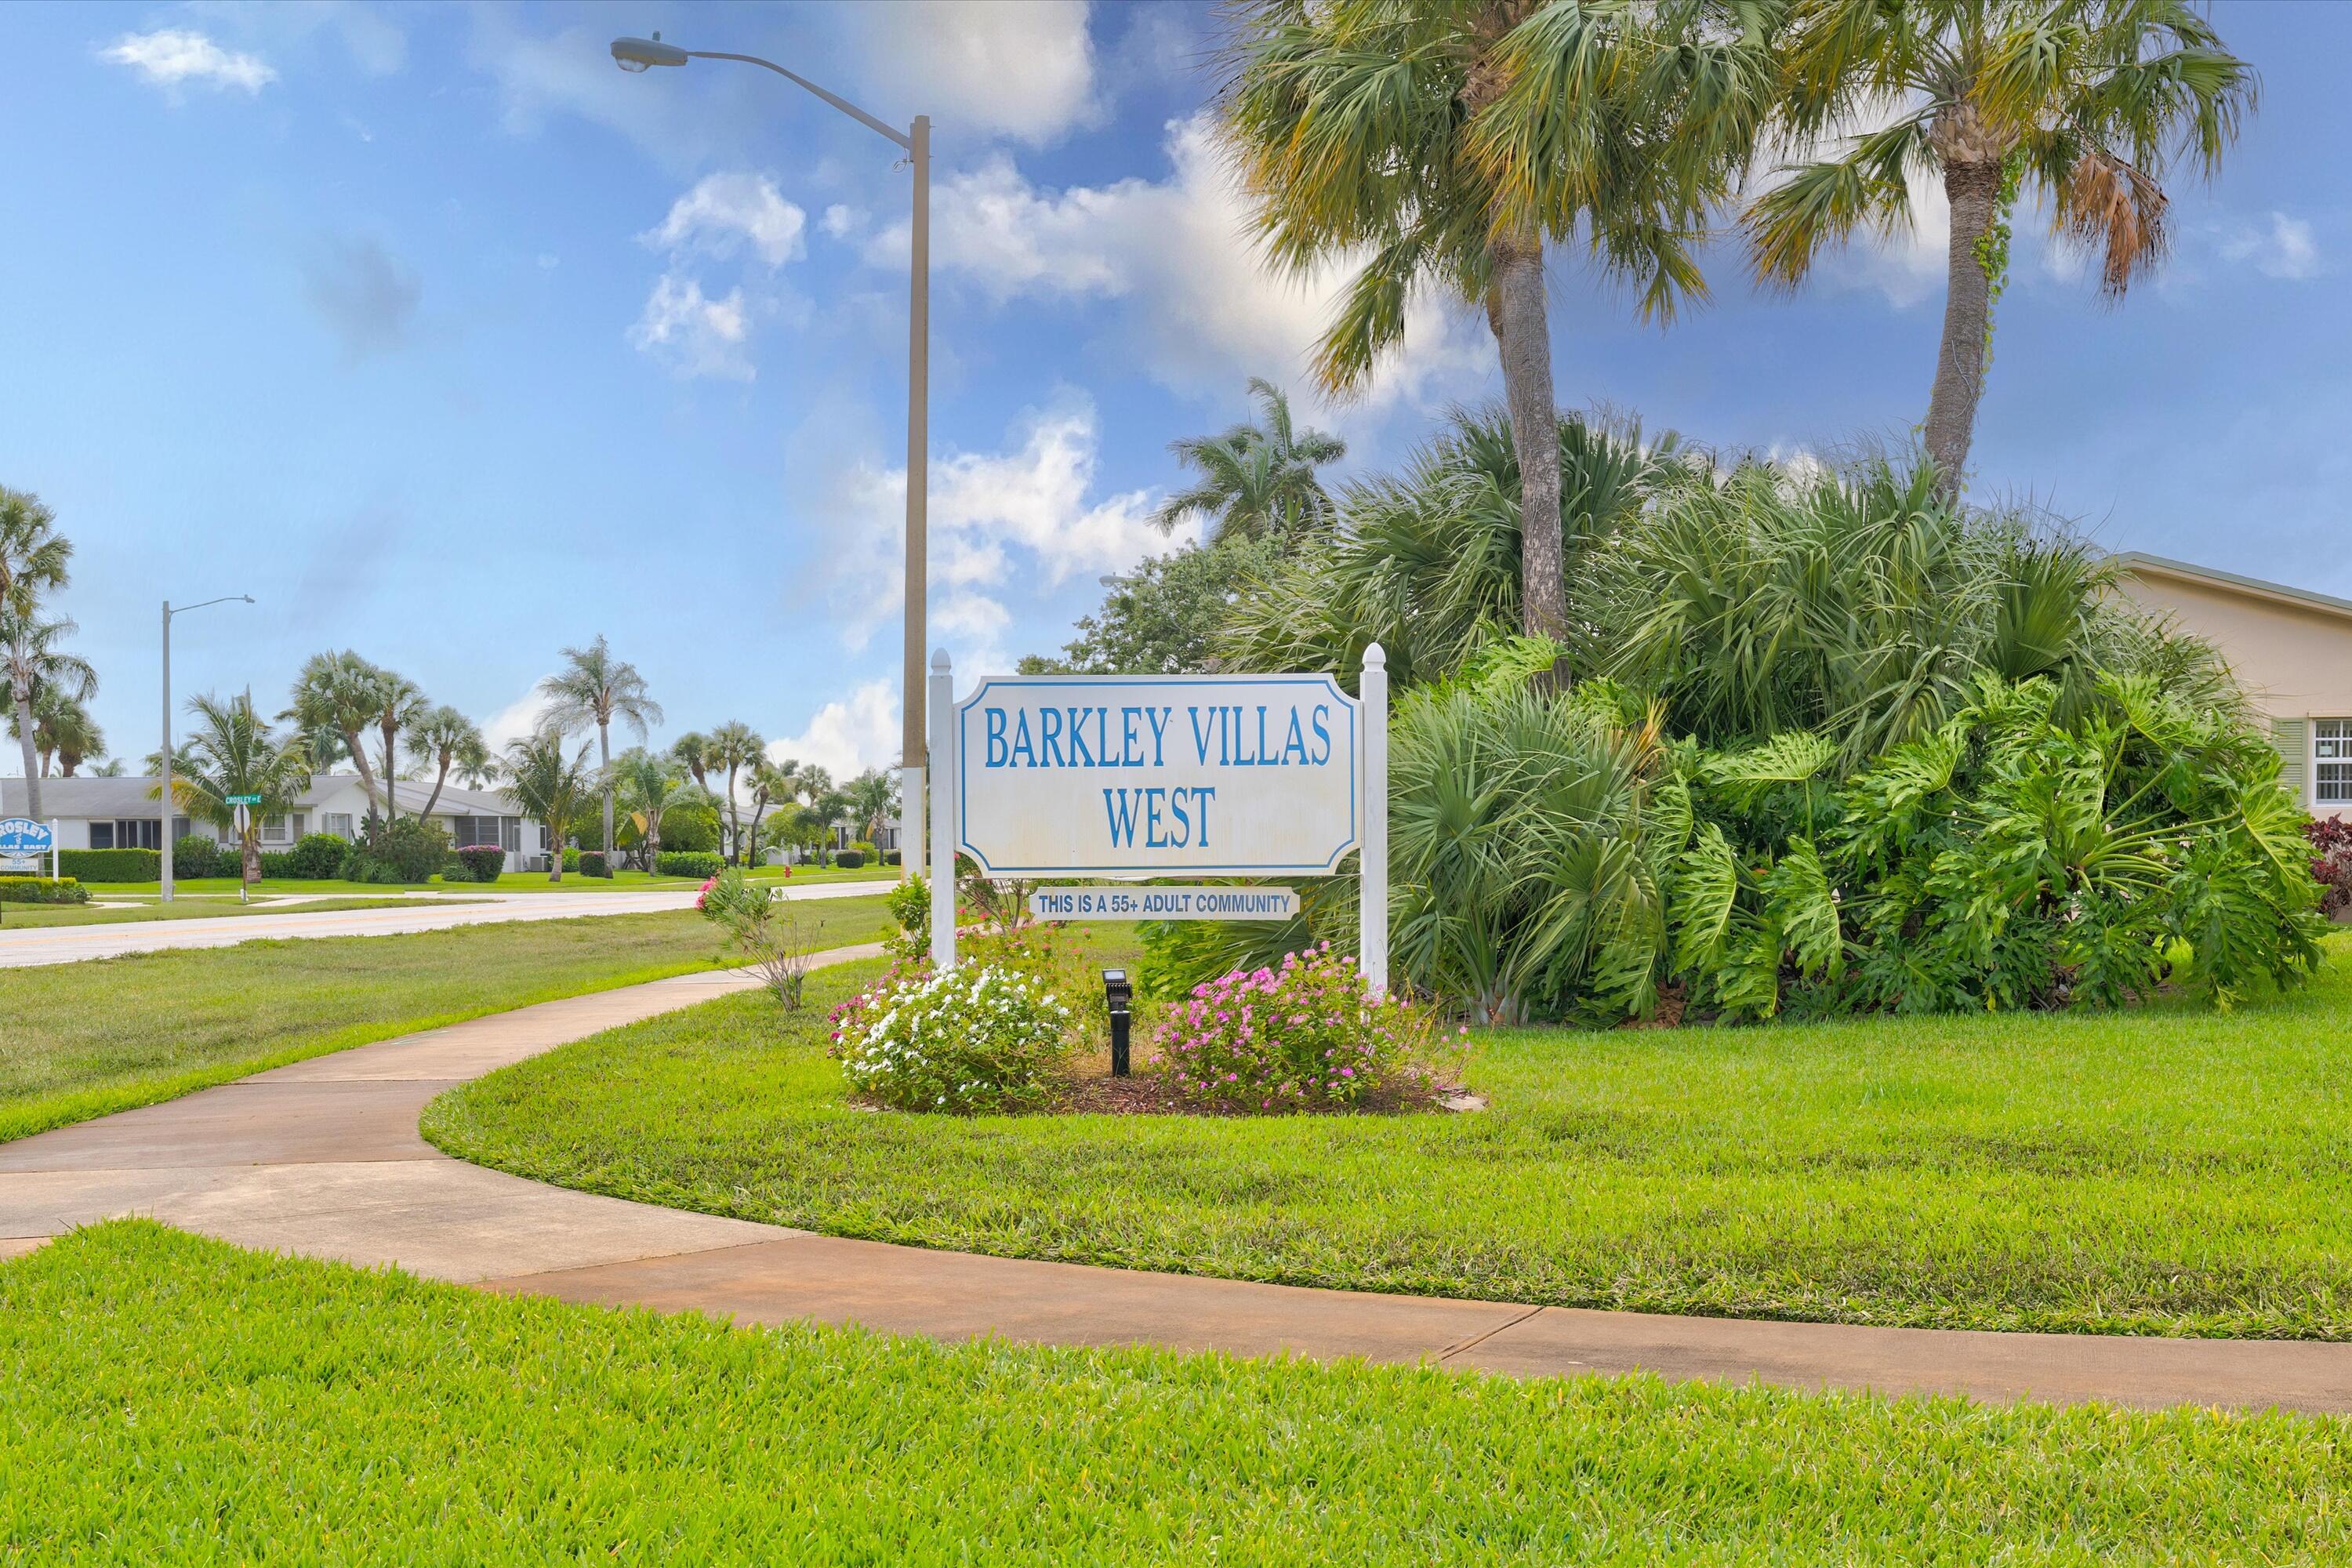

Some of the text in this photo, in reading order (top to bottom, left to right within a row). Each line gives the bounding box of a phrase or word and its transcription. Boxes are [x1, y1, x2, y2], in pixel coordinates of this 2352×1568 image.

[985, 704, 1331, 768] BARKLEY VILLAS
[1102, 786, 1216, 849] WEST
[1039, 894, 1290, 913] THIS IS A 55+ ADULT COMMUNITY
